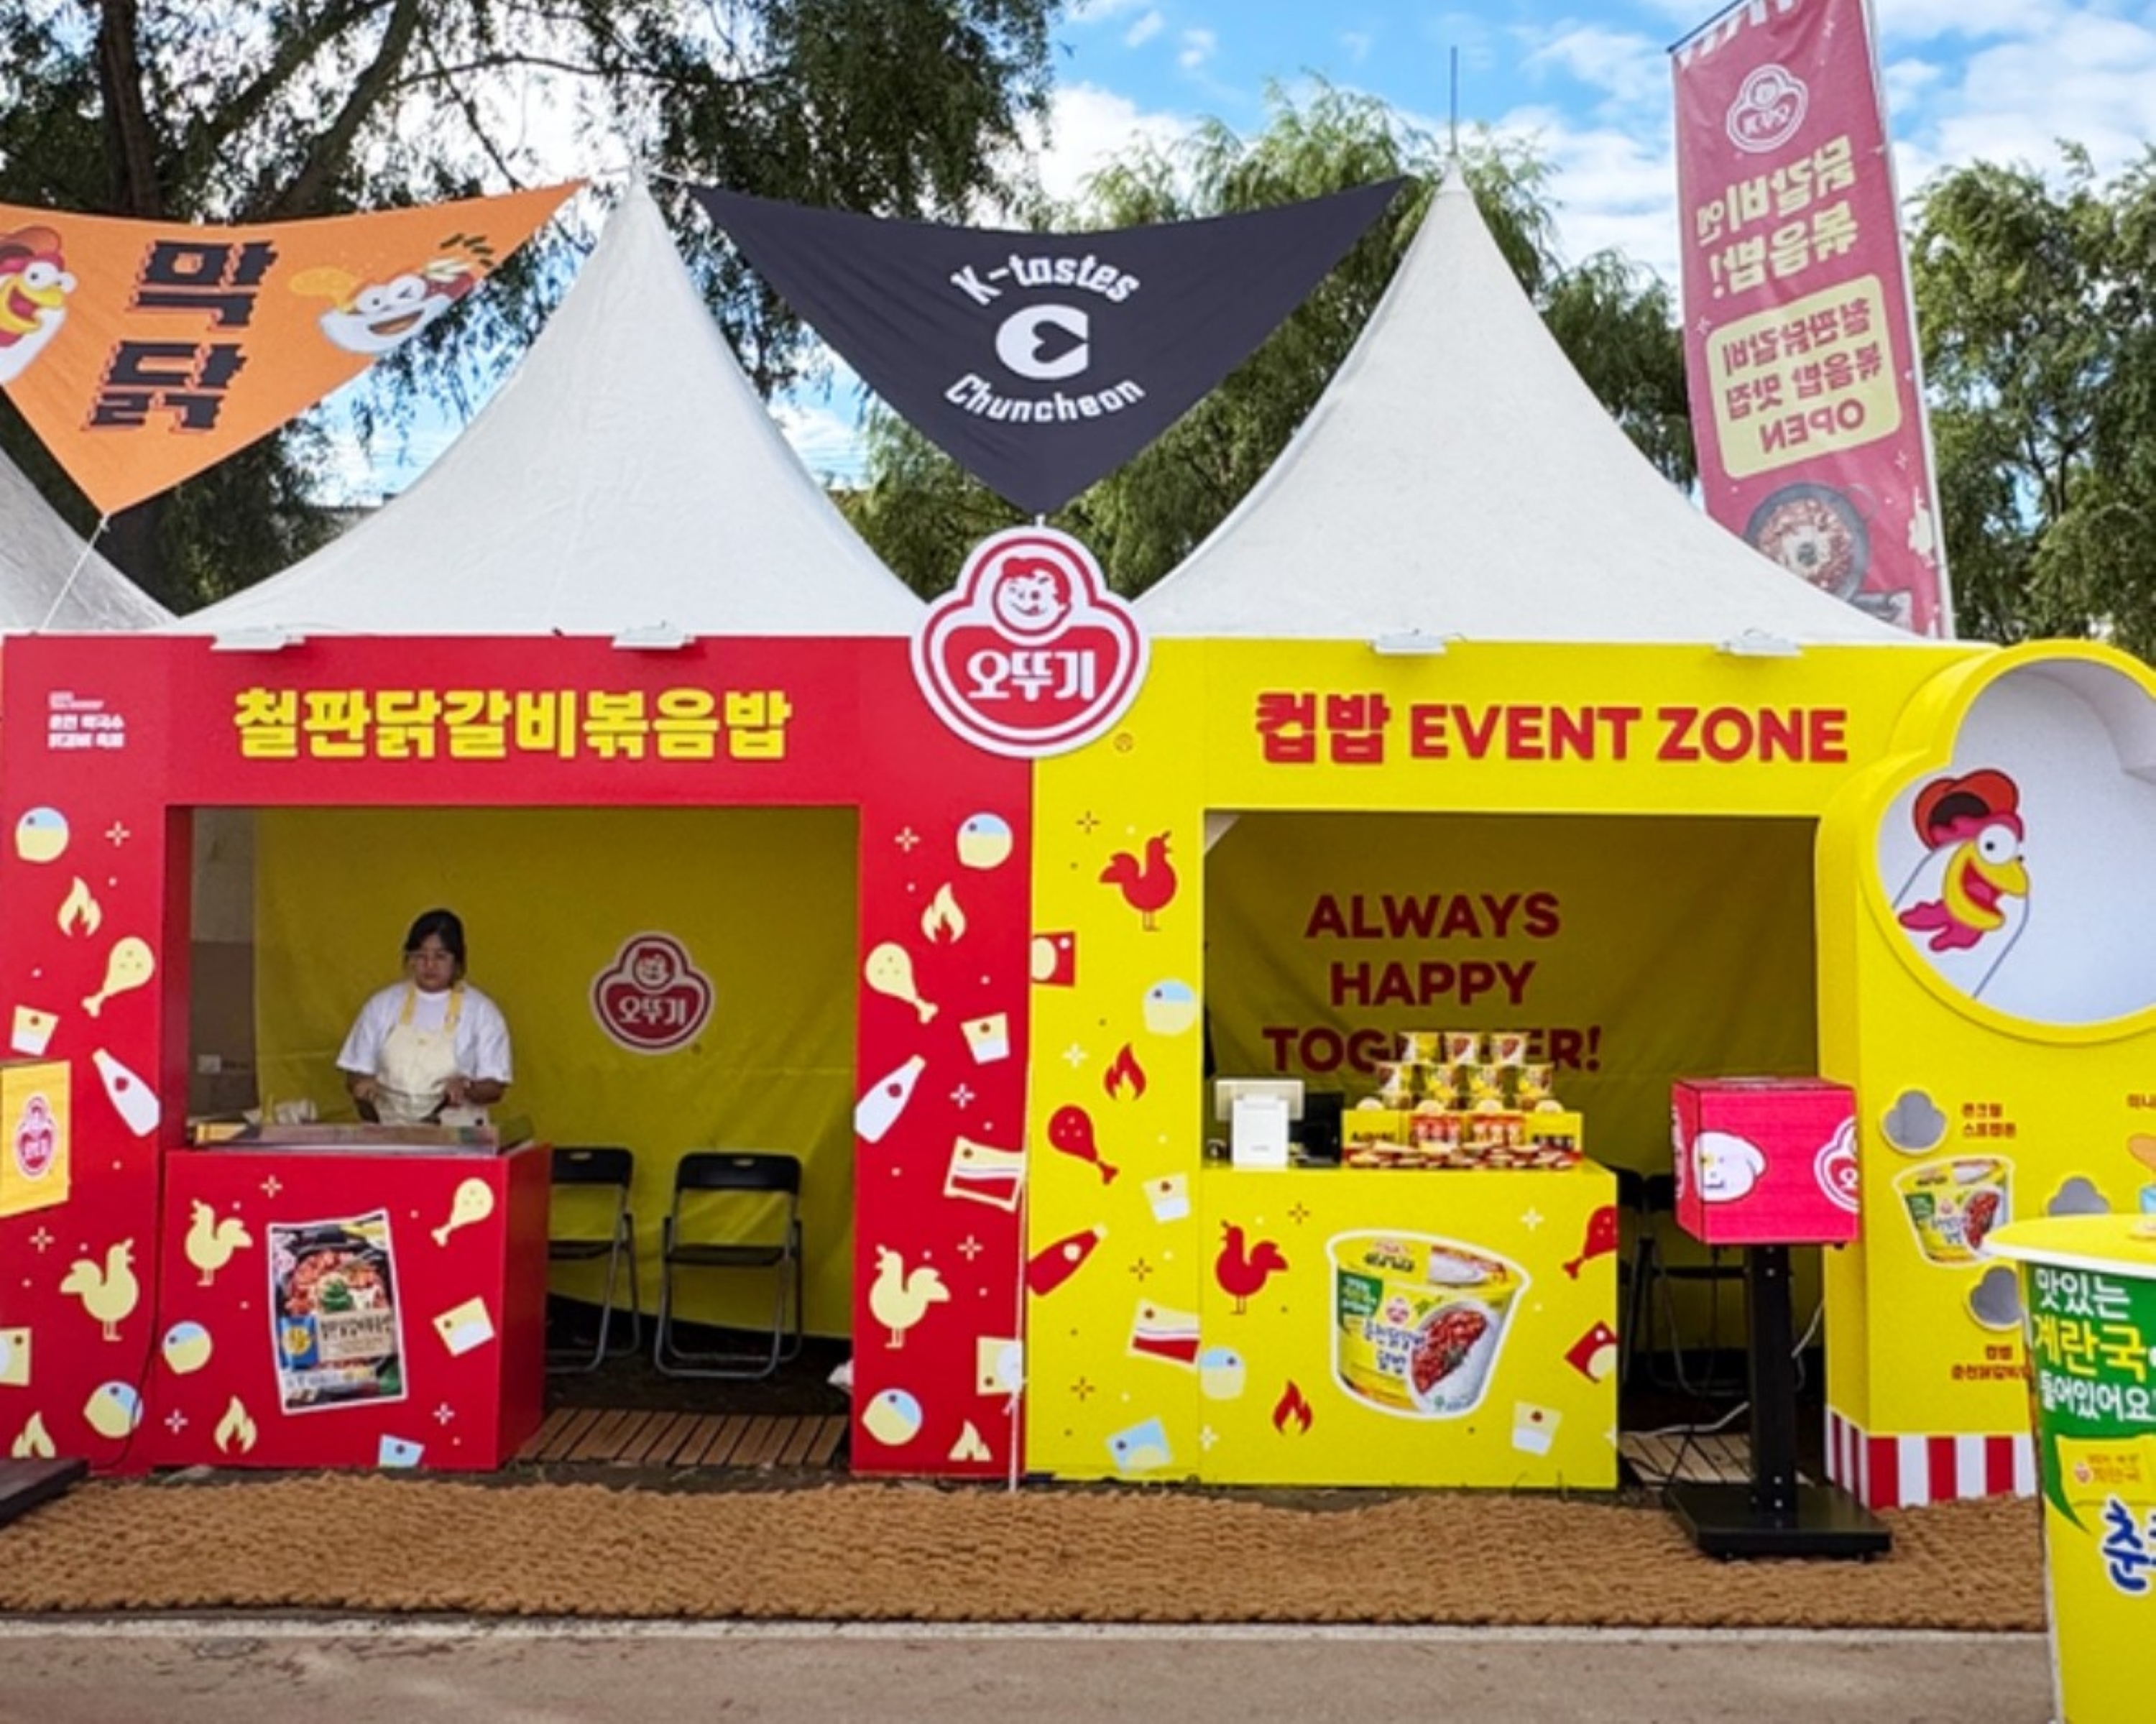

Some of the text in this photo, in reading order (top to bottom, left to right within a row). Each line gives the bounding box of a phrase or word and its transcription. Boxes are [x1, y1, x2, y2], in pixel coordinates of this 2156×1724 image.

[951, 254, 1141, 305] K-tastes
[945, 372, 1145, 423] Chuncheon
[966, 649, 1096, 702] 오뚜기
[234, 688, 791, 758] 철판닭갈비볶음밥
[1256, 693, 1848, 764] 컵밥 EVENT ZONE
[1304, 892, 1560, 939] ALWAYS
[1330, 960, 1537, 1007] HAPPY
[618, 995, 686, 1025] 오뚜기
[2035, 1267, 2132, 1320] 맛있는
[2102, 1499, 2156, 1591] 춘
